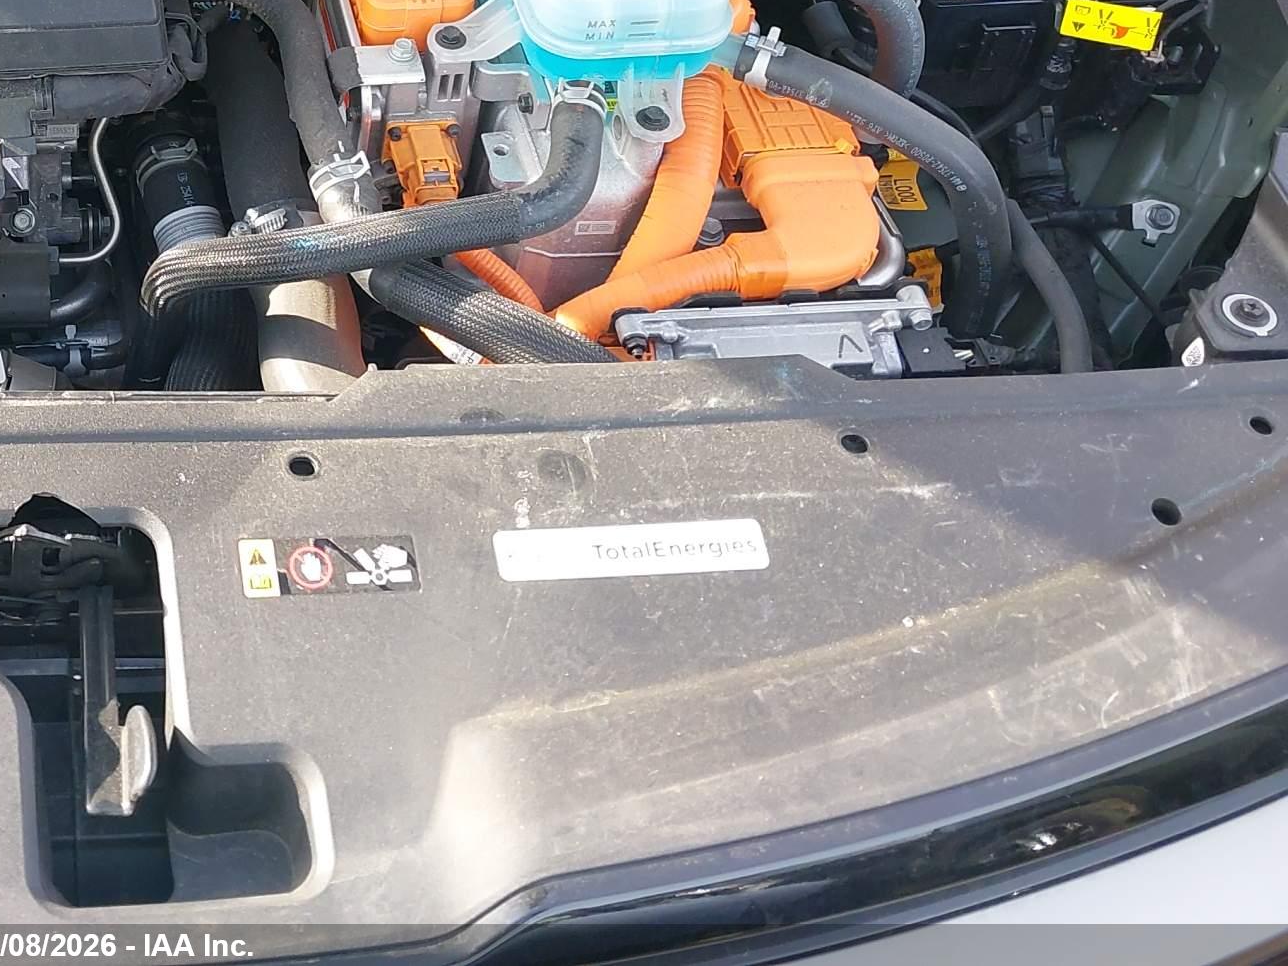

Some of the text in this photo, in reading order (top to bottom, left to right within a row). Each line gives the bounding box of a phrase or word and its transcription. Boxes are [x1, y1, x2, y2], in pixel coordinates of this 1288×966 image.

[587, 19, 616, 29] MAX
[585, 31, 615, 41] MIN
[592, 538, 758, 561] TotalEnergies
